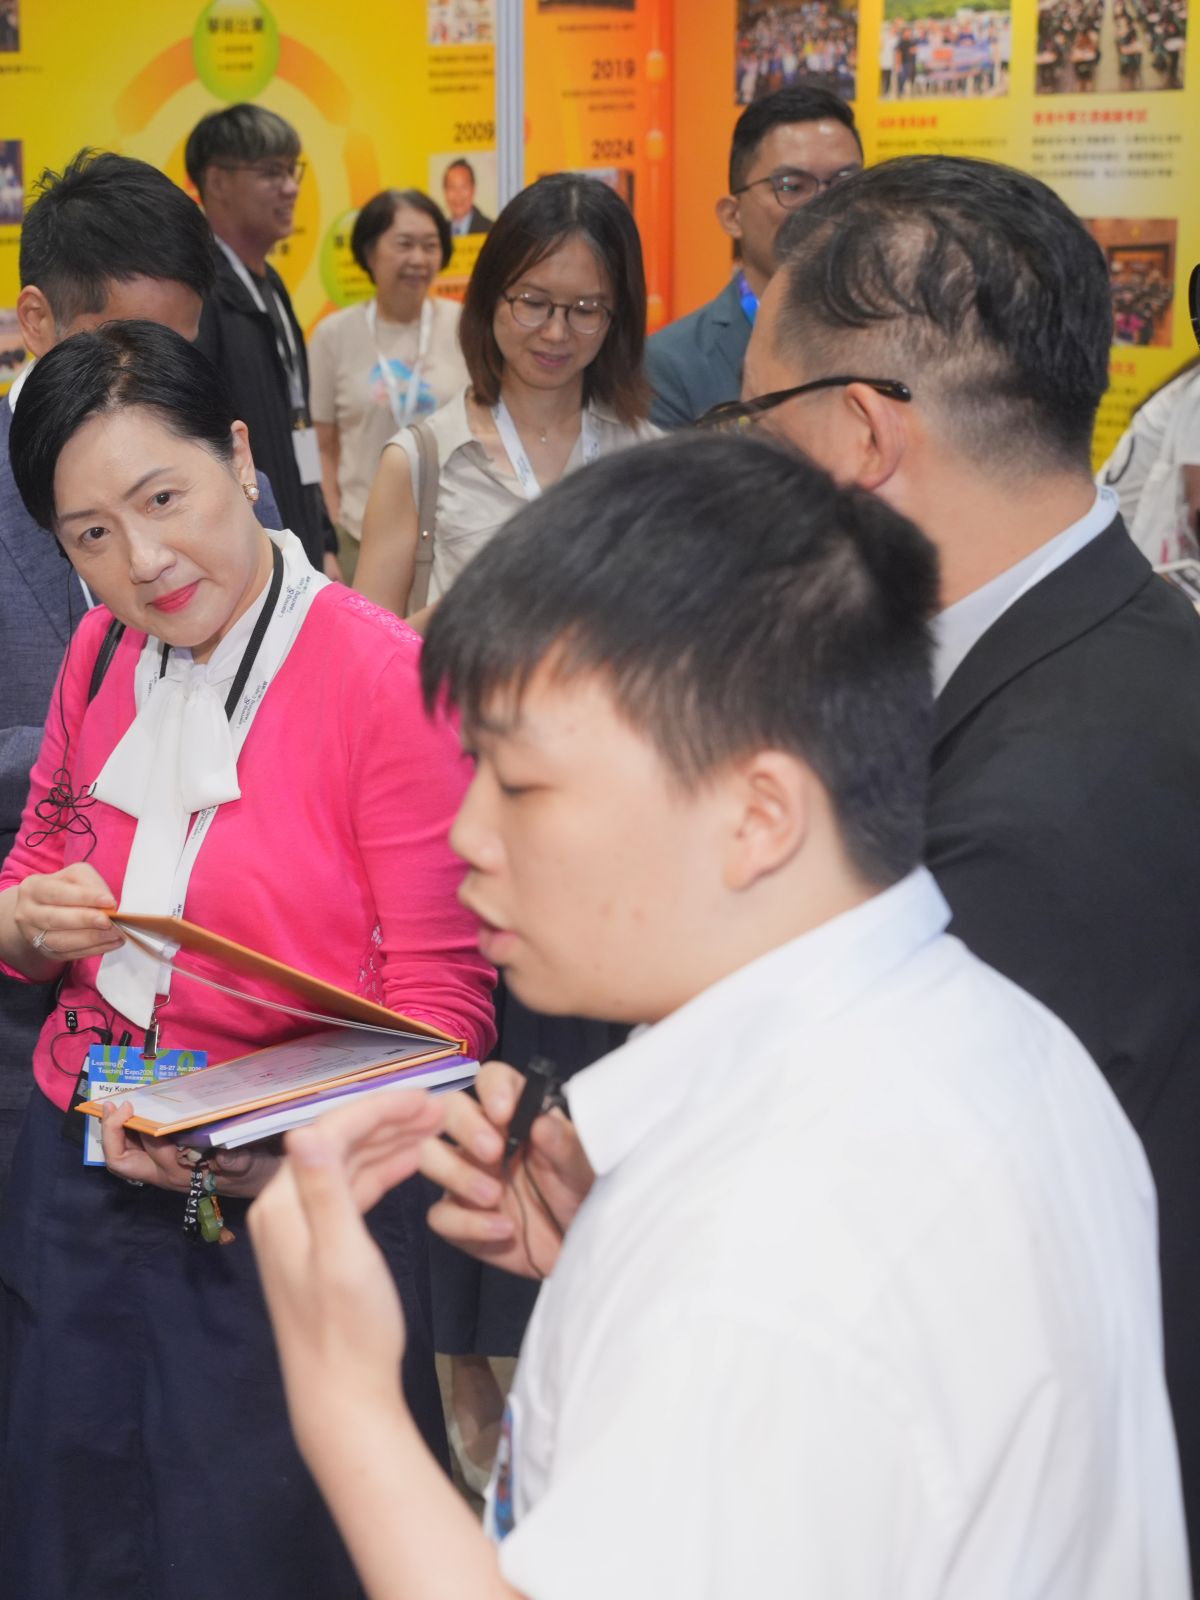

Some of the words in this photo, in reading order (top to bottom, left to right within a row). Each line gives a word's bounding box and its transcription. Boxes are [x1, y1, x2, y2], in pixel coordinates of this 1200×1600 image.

[592, 60, 635, 80] 2019
[454, 121, 494, 143] 2009
[592, 139, 634, 160] 2024
[92, 1060, 117, 1068] Learning
[98, 1067, 123, 1076] Teaching
